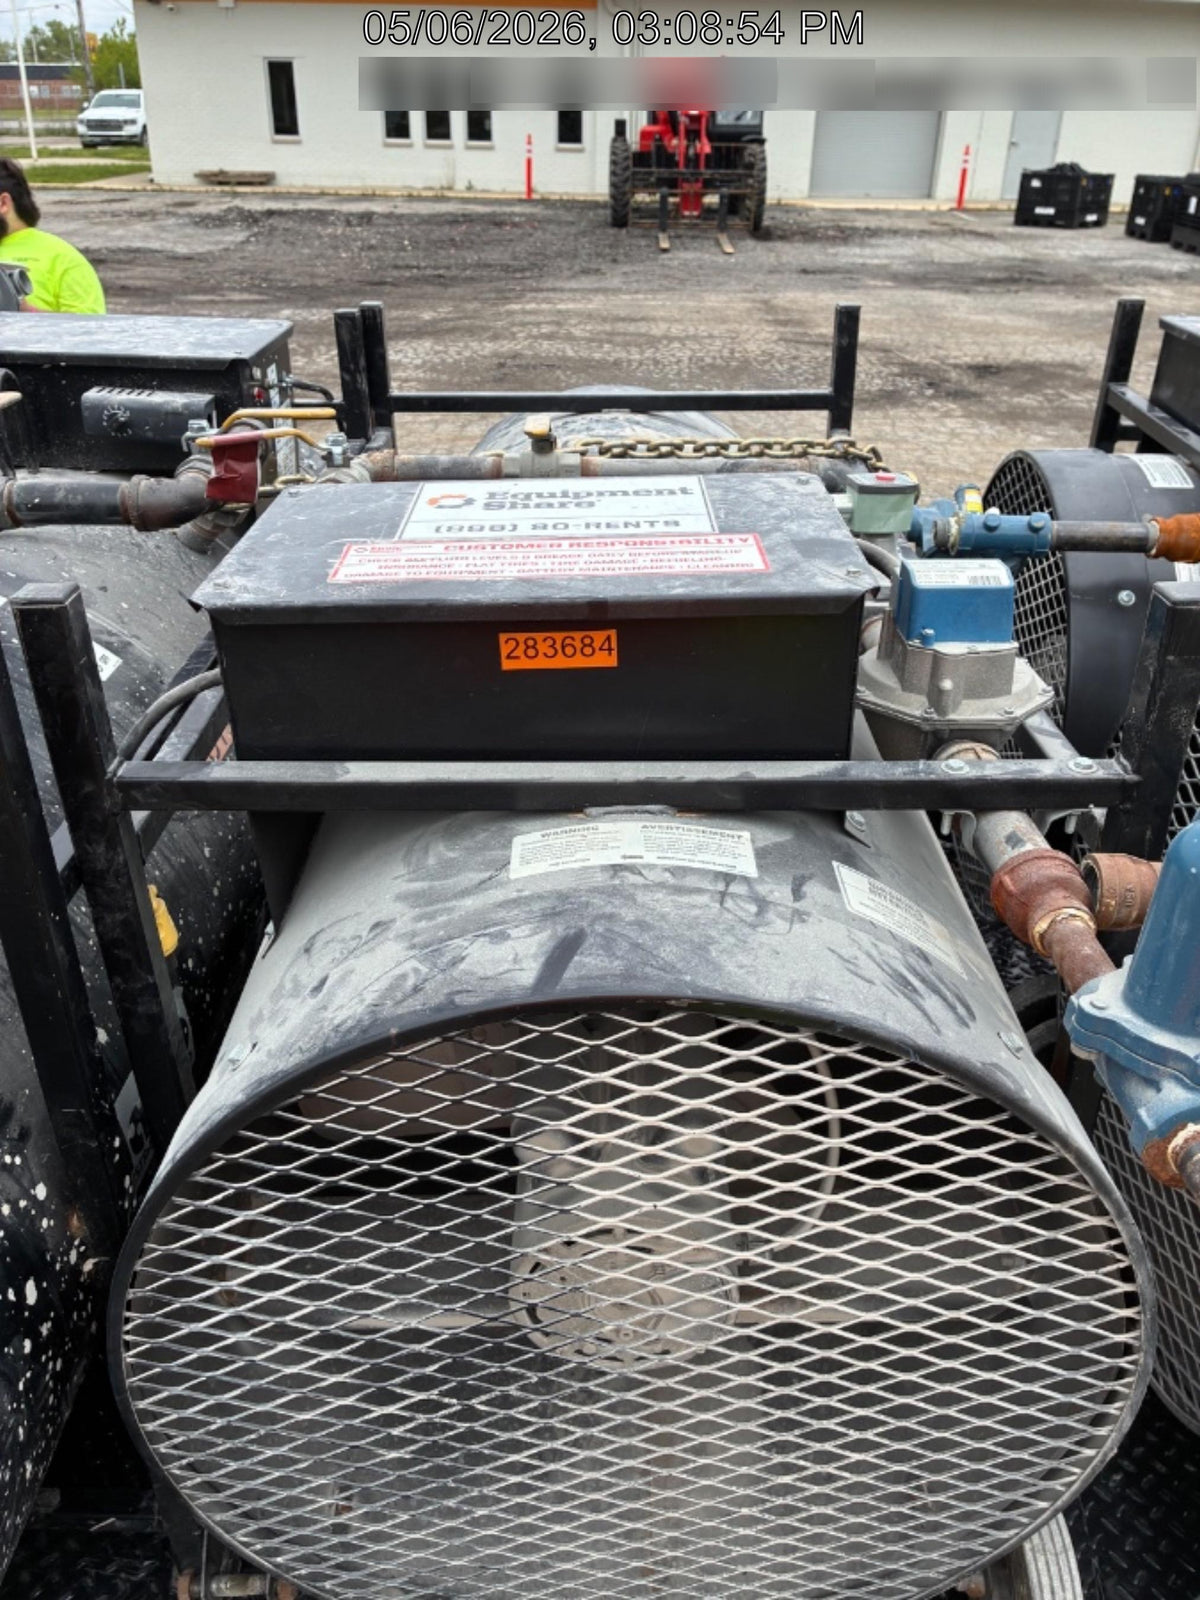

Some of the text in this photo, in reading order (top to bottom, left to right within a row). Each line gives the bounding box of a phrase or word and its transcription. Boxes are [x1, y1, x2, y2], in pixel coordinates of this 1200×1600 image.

[486, 487, 694, 500] Equipment
[444, 542, 562, 552] CUSTOMER
[568, 537, 750, 548] RESPONSIBILITY
[504, 634, 615, 660] 283684
